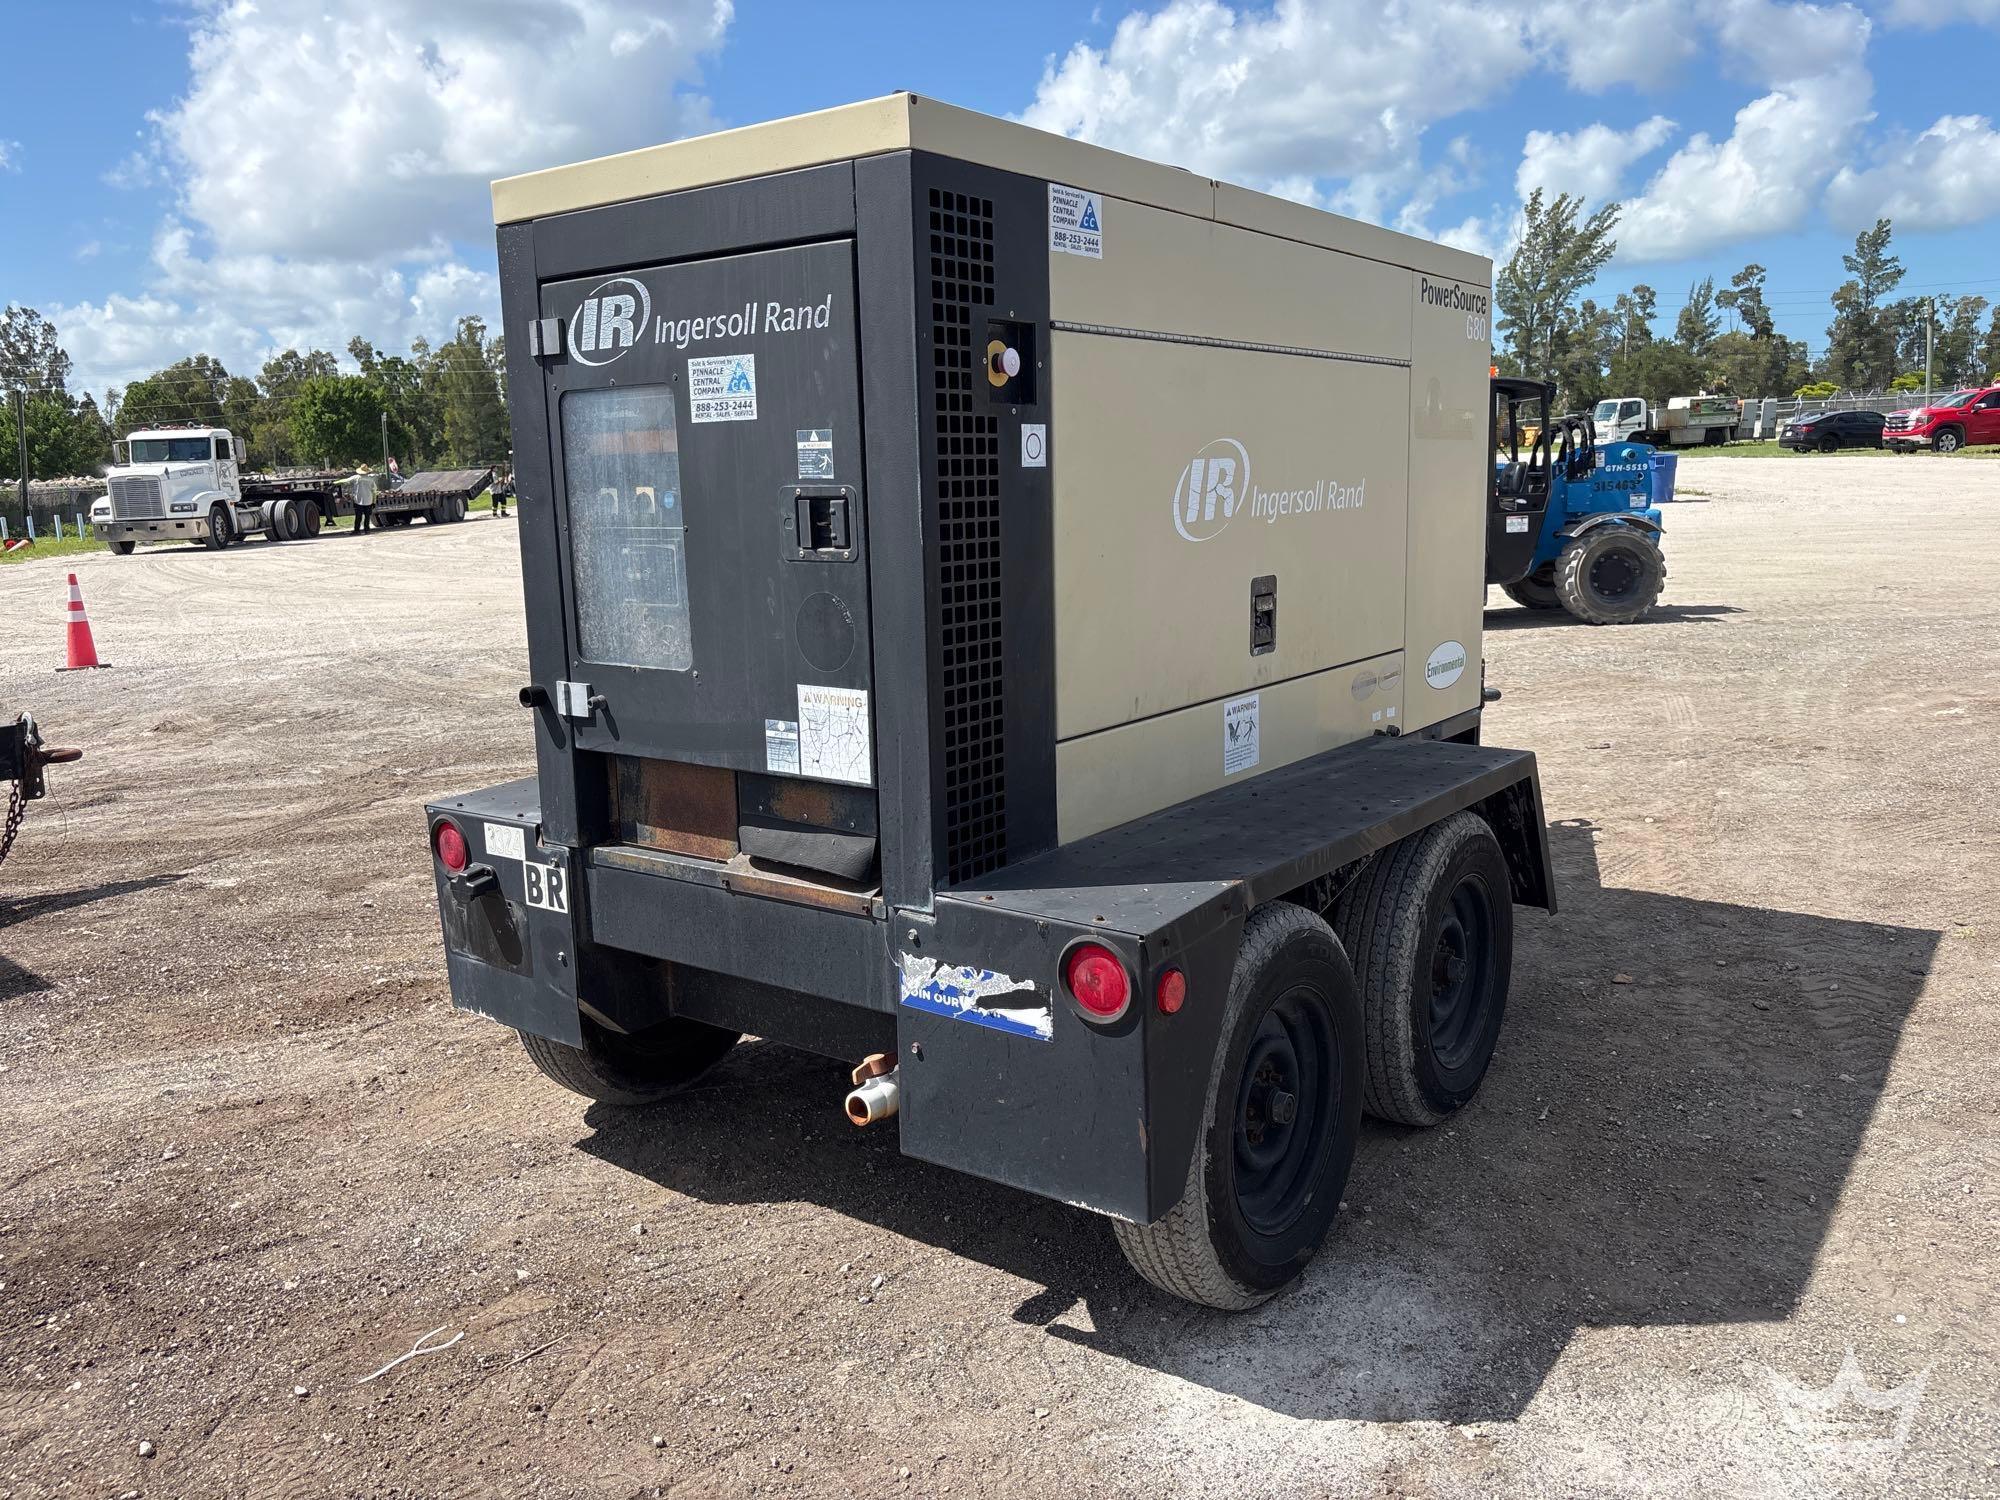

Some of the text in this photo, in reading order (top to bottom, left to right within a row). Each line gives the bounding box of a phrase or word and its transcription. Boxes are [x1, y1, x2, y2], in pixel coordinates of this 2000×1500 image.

[1053, 196, 1078, 208] PINNACLE
[1053, 205, 1075, 217] CENTRAL
[1053, 215, 1078, 226] COMPANY
[1054, 231, 1098, 247] 888-253-2444
[1421, 277, 1487, 314] PowerSource
[581, 294, 832, 351] IR Ingersoll Rand
[1467, 314, 1486, 341] G80
[692, 367, 724, 377] PINNACLE
[693, 377, 720, 386] CENTRAL
[693, 386, 724, 395] COMPANY
[696, 401, 753, 412] 888-253-2444
[1605, 463, 1648, 472] GTH-5519
[1186, 458, 1366, 524] IR Ingersoll Rand
[1426, 654, 1465, 678] Environmental
[812, 693, 863, 708] WARNING
[1231, 700, 1257, 715] WARNING
[525, 864, 566, 910] BR
[908, 987, 960, 1008] OIN OUR
